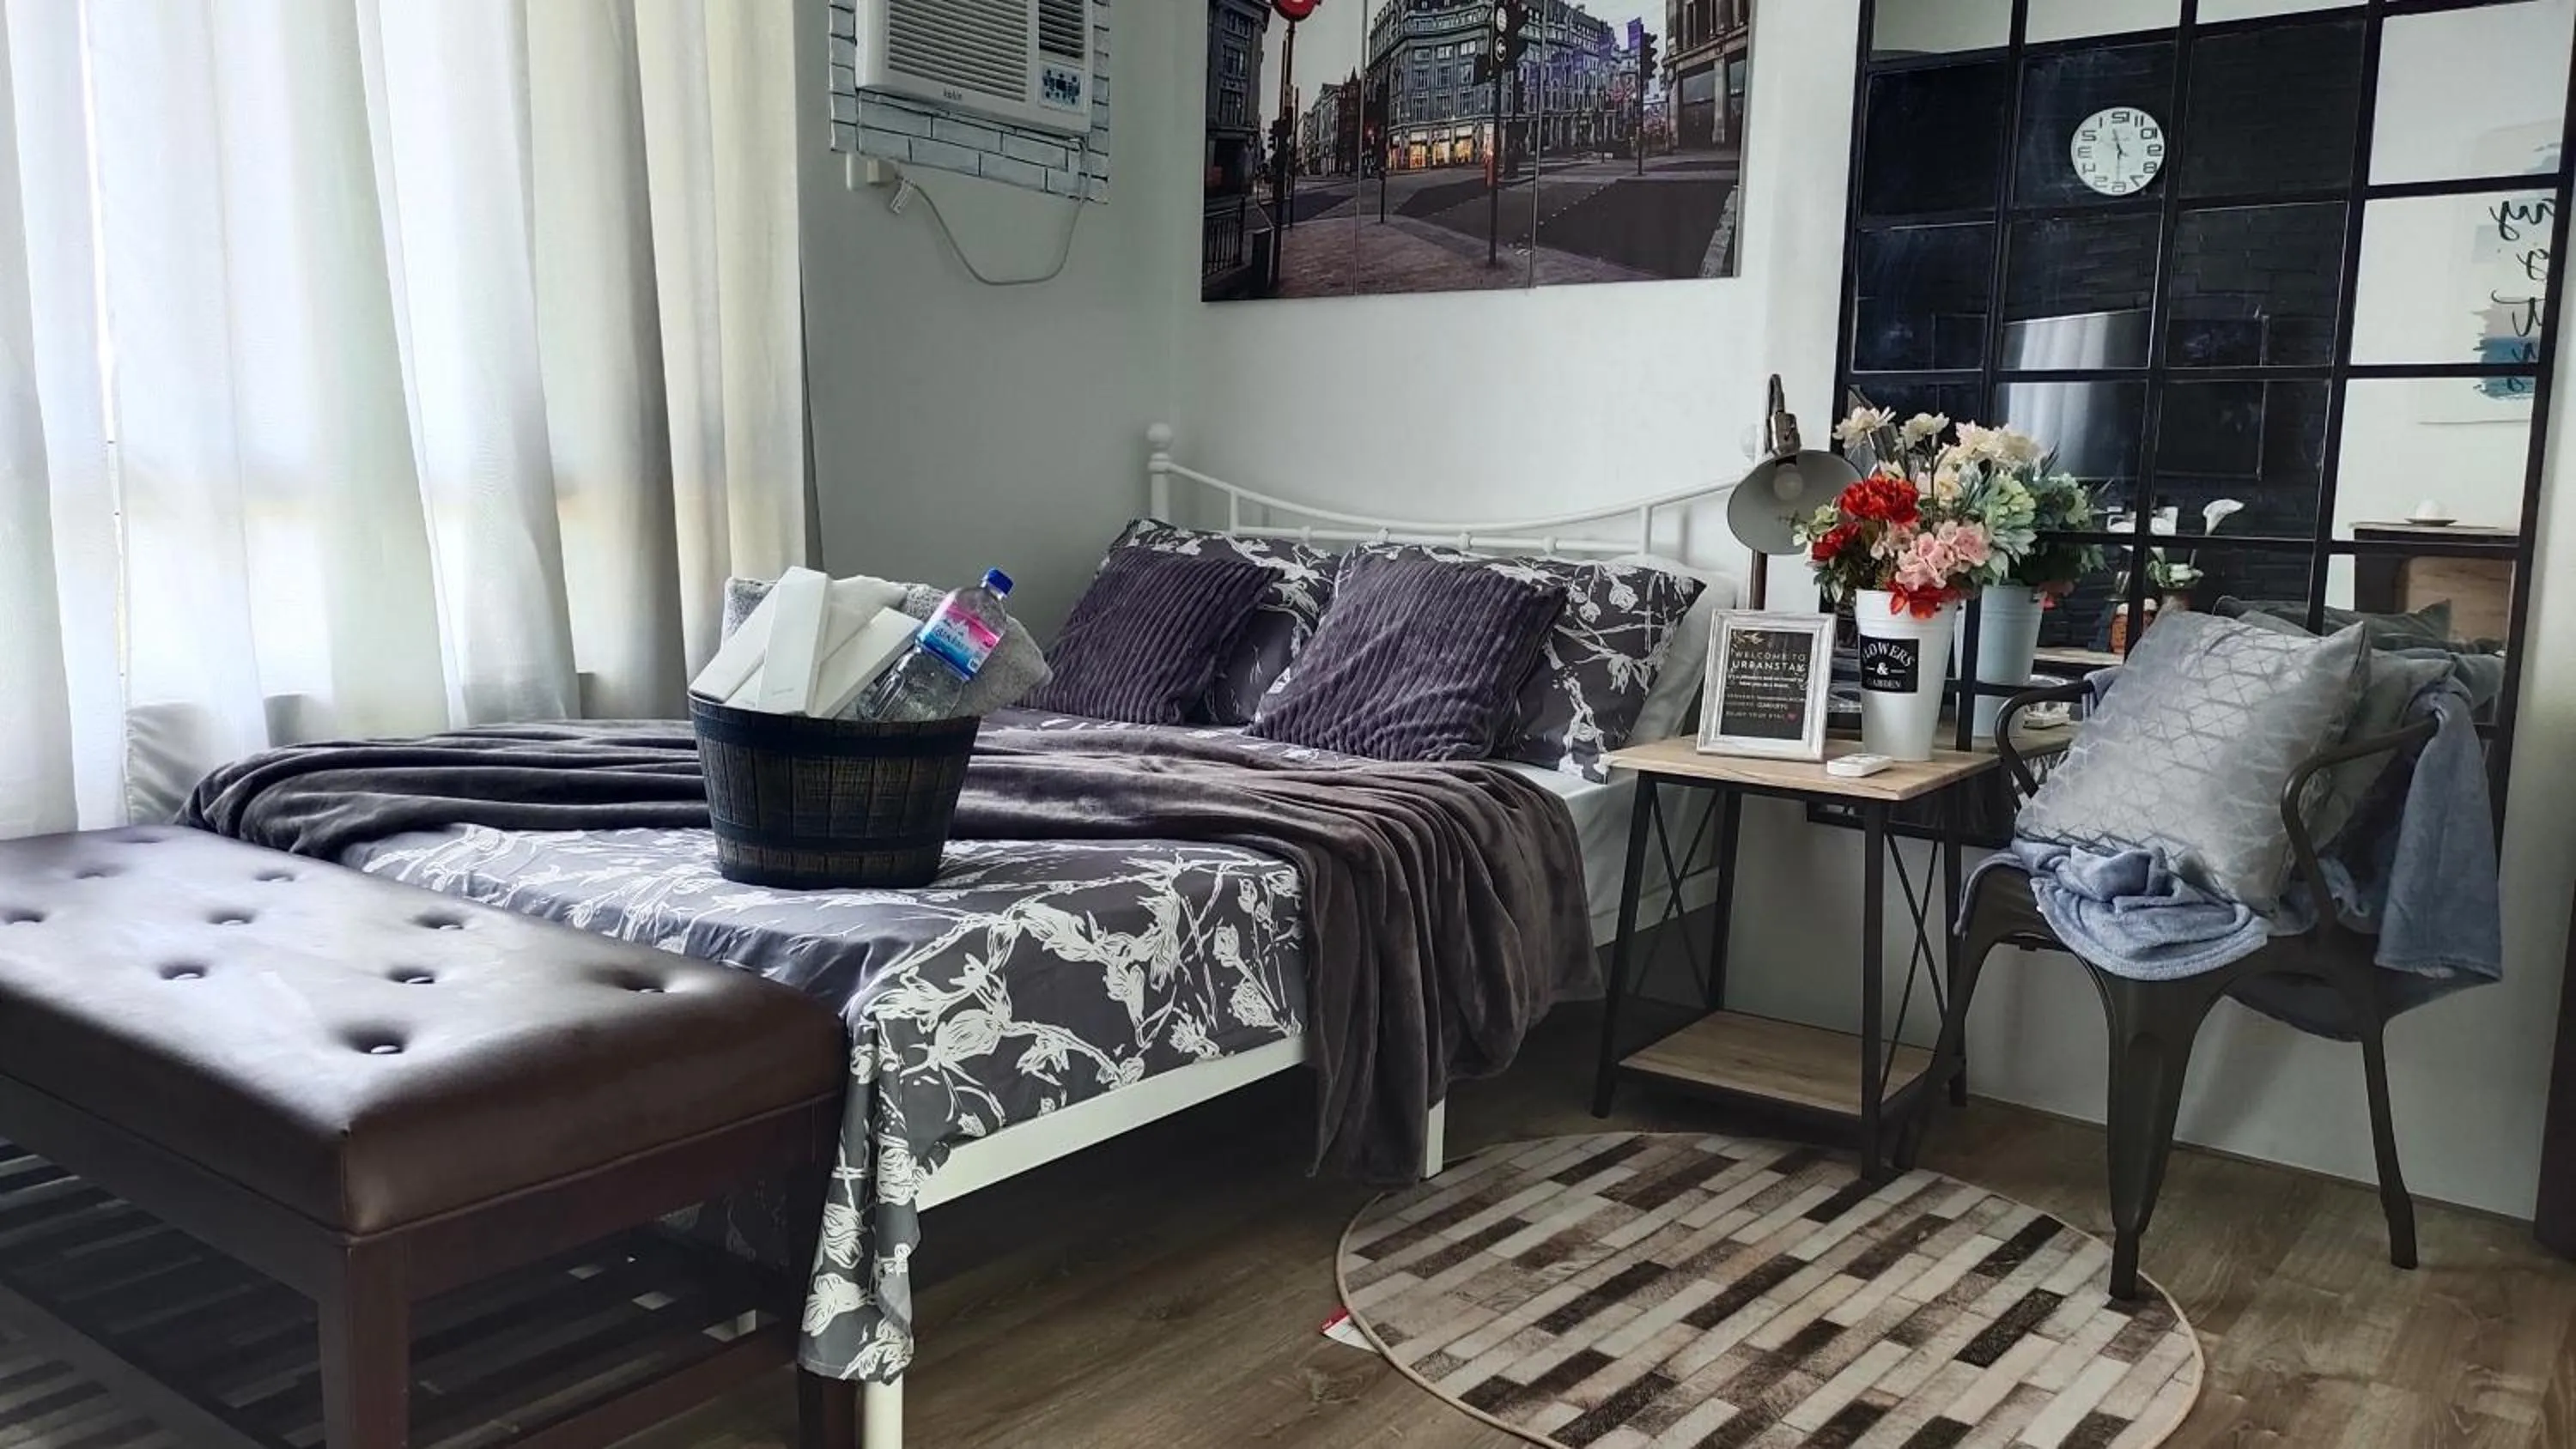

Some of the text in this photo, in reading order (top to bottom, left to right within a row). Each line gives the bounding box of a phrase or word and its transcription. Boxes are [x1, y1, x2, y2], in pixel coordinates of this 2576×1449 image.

[1735, 650, 1807, 663] WELCOME TO
[1876, 662, 1889, 676] &
